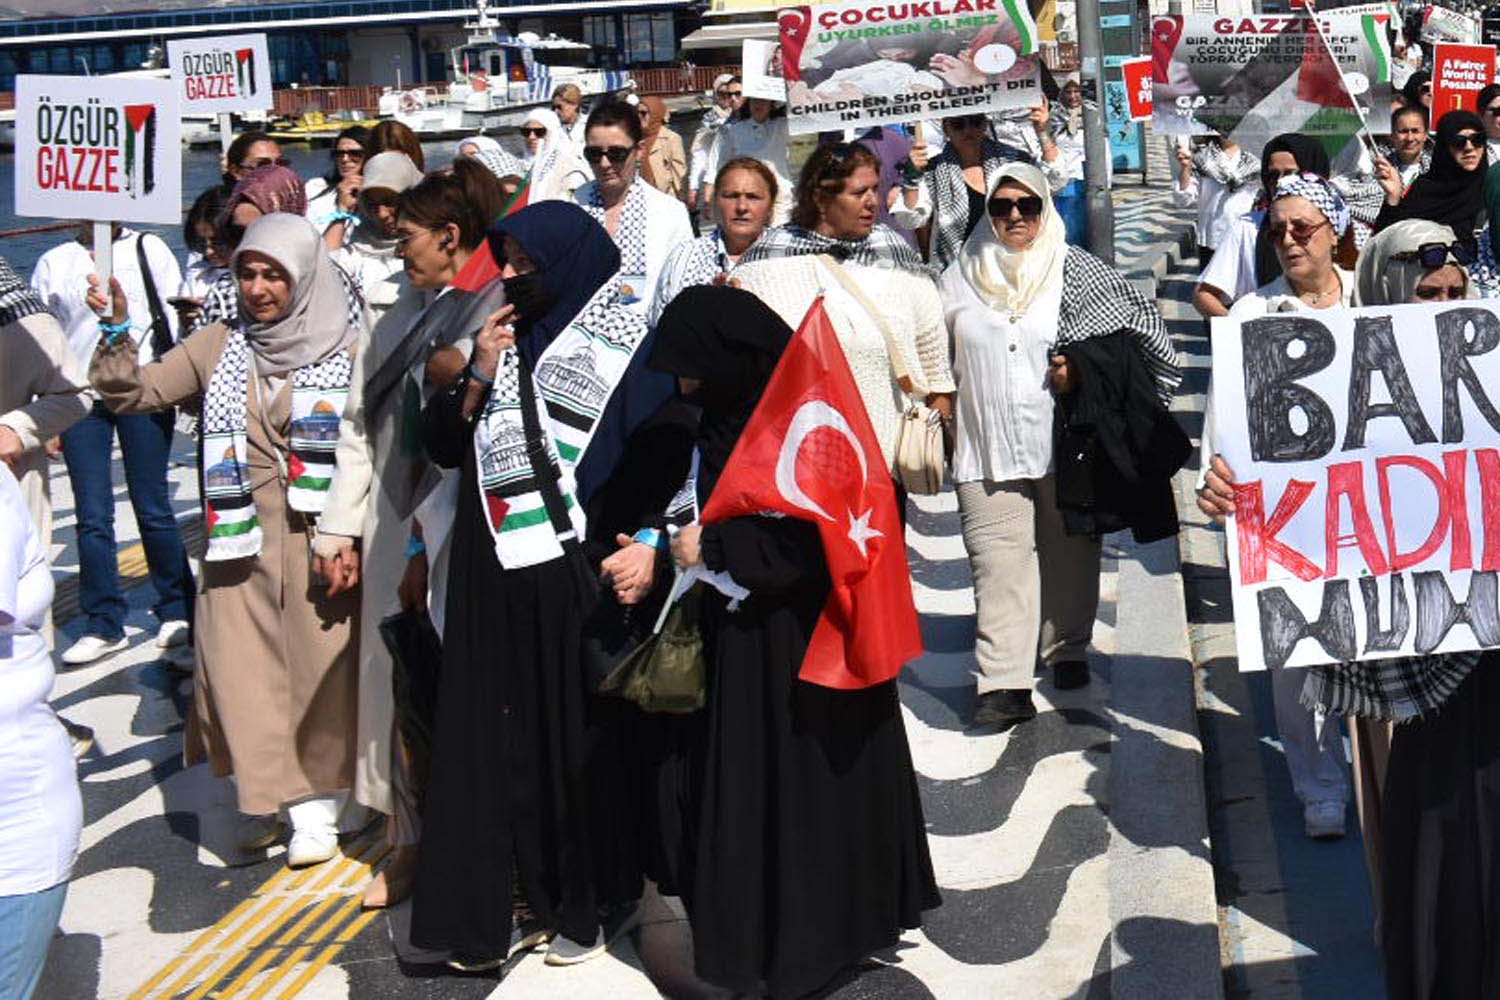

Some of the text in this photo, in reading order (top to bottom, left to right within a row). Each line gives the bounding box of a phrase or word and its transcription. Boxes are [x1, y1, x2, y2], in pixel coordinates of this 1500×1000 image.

[818, 14, 999, 44] UYURKEN ÖLMEZ
[183, 48, 234, 76] ÖZGÜR
[1442, 68, 1475, 79] World
[1443, 59, 1488, 71] A Fairer
[184, 74, 237, 100] GAZZE
[791, 78, 1036, 116] CHILDREN SHOULDN'T DIE
[1440, 79, 1487, 90] Possible
[37, 96, 119, 147] ÖZGÜR
[839, 95, 993, 122] IN THEIR SLEEP!
[37, 146, 119, 193] GAZZE
